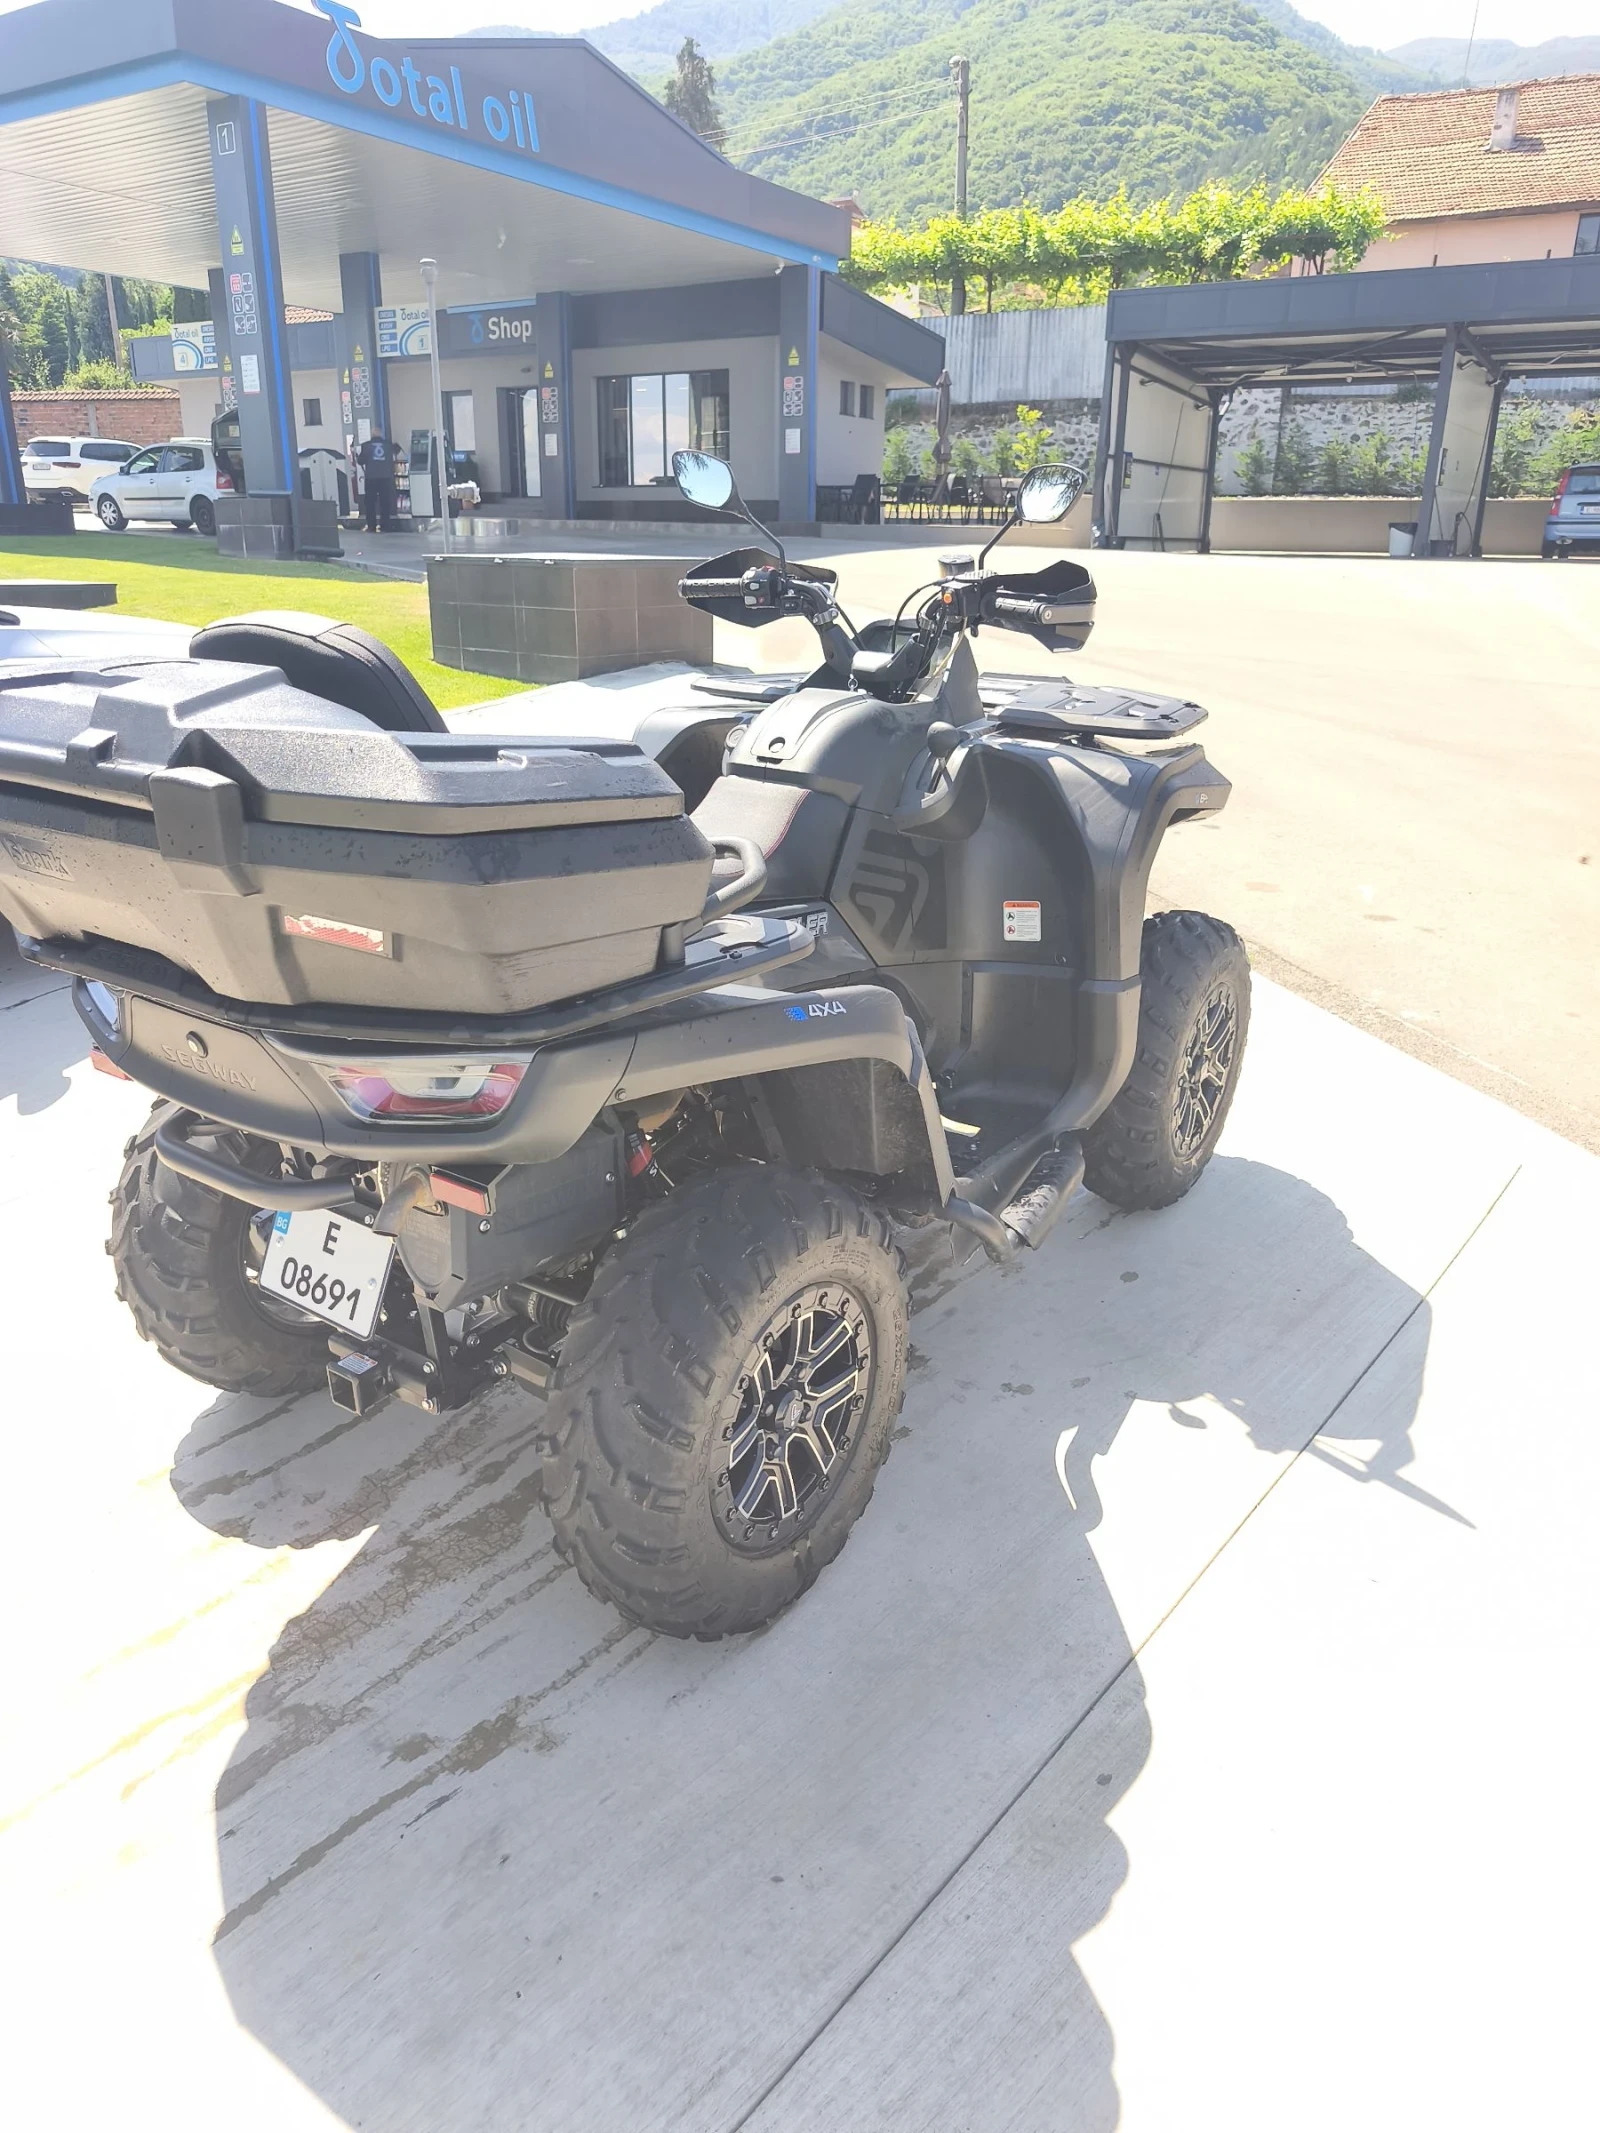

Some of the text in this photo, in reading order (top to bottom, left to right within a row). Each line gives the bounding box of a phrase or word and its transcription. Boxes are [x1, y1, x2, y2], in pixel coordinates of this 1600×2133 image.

[482, 90, 540, 153] oil
[221, 126, 230, 150] 1
[488, 316, 532, 343] Shop
[808, 1001, 847, 1018] 4X4
[161, 1043, 257, 1092] SEGWAY
[275, 1216, 288, 1230] BG
[322, 1220, 341, 1256] E
[280, 1256, 361, 1321] 08691
